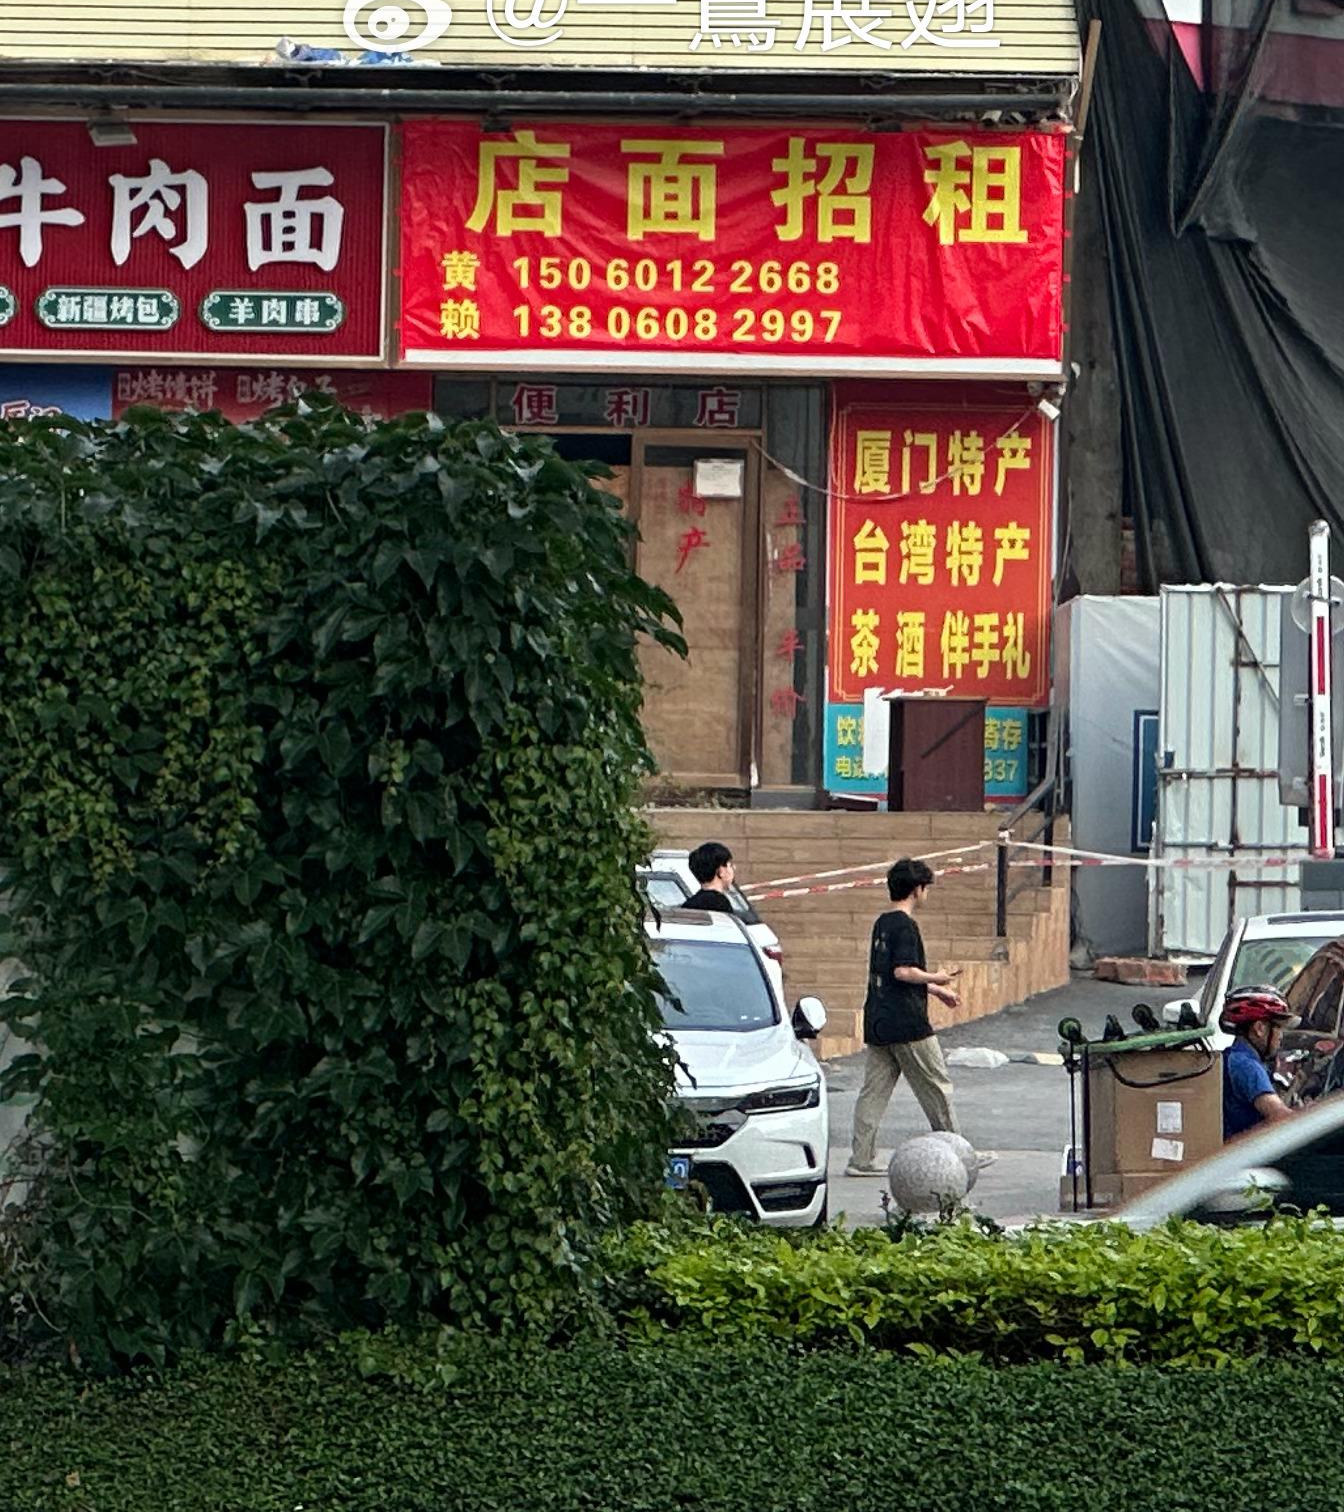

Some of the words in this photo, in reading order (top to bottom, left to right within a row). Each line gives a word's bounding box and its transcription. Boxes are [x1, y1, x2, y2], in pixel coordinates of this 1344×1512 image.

[464, 130, 1030, 246] 店面招租
[440, 250, 478, 292] 黄
[512, 256, 592, 290] 150
[605, 257, 716, 293] 6012
[729, 259, 841, 295] 2668
[56, 295, 161, 324] 新疆烤包
[228, 297, 321, 325] 羊肉串
[438, 298, 481, 340] 赖
[512, 304, 592, 338] 138
[606, 306, 719, 340] 0608
[731, 308, 843, 343] 2997
[511, 382, 742, 428] 便利店
[853, 429, 1033, 497] 厦门特产
[852, 518, 1032, 587] 台湾特产
[849, 608, 881, 678] 茶
[895, 610, 926, 679] 酒
[940, 609, 1032, 681] 伴手礼
